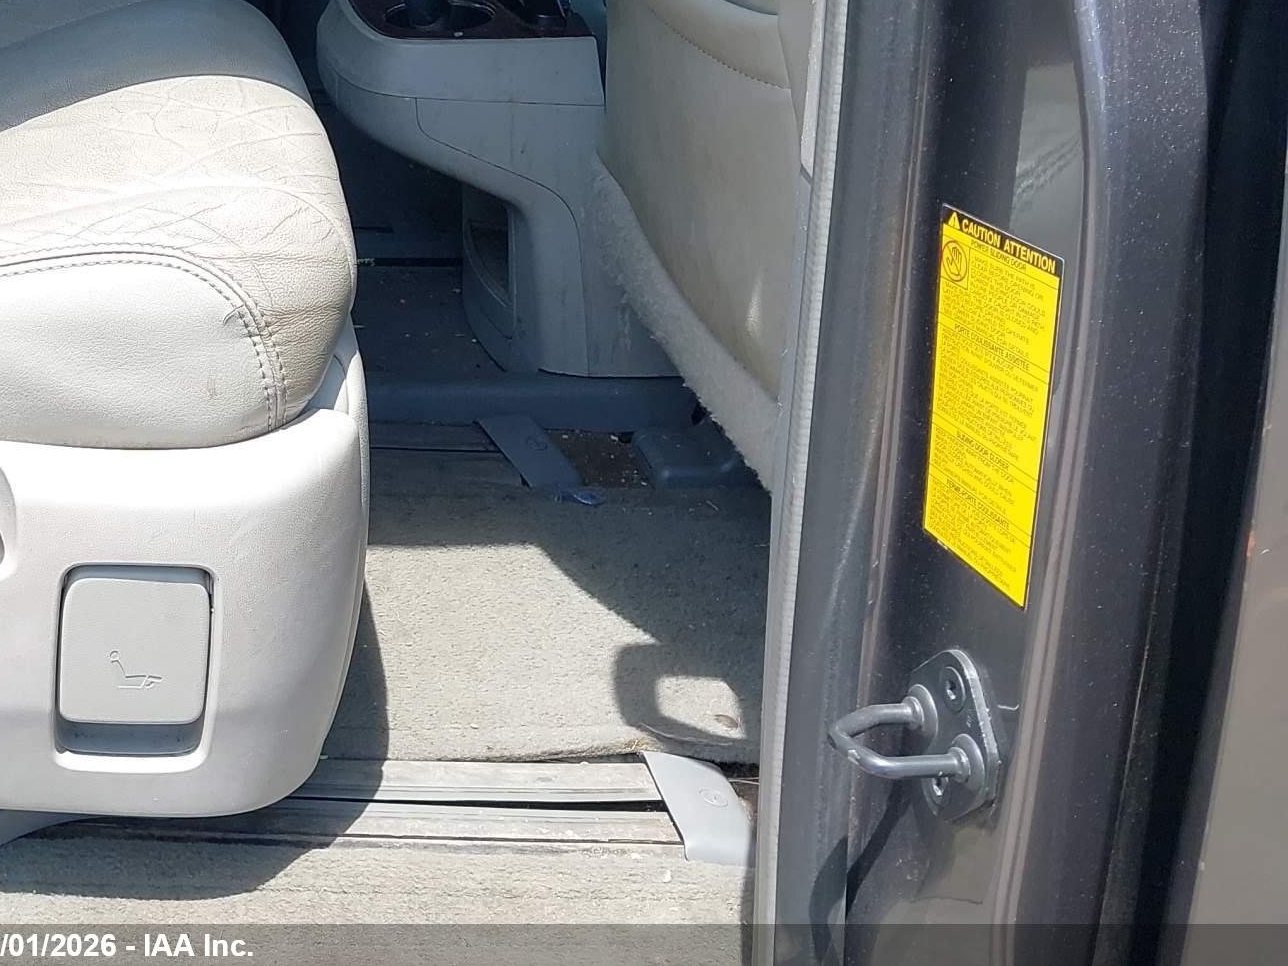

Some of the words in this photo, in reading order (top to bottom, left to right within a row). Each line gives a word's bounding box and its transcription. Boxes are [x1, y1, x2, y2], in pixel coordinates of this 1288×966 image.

[962, 218, 1000, 248] CAUTION
[1003, 238, 1055, 274] ATTENTION
[970, 238, 988, 253] POWER
[989, 247, 1009, 263] SLIDING
[1010, 257, 1026, 271] DOOR
